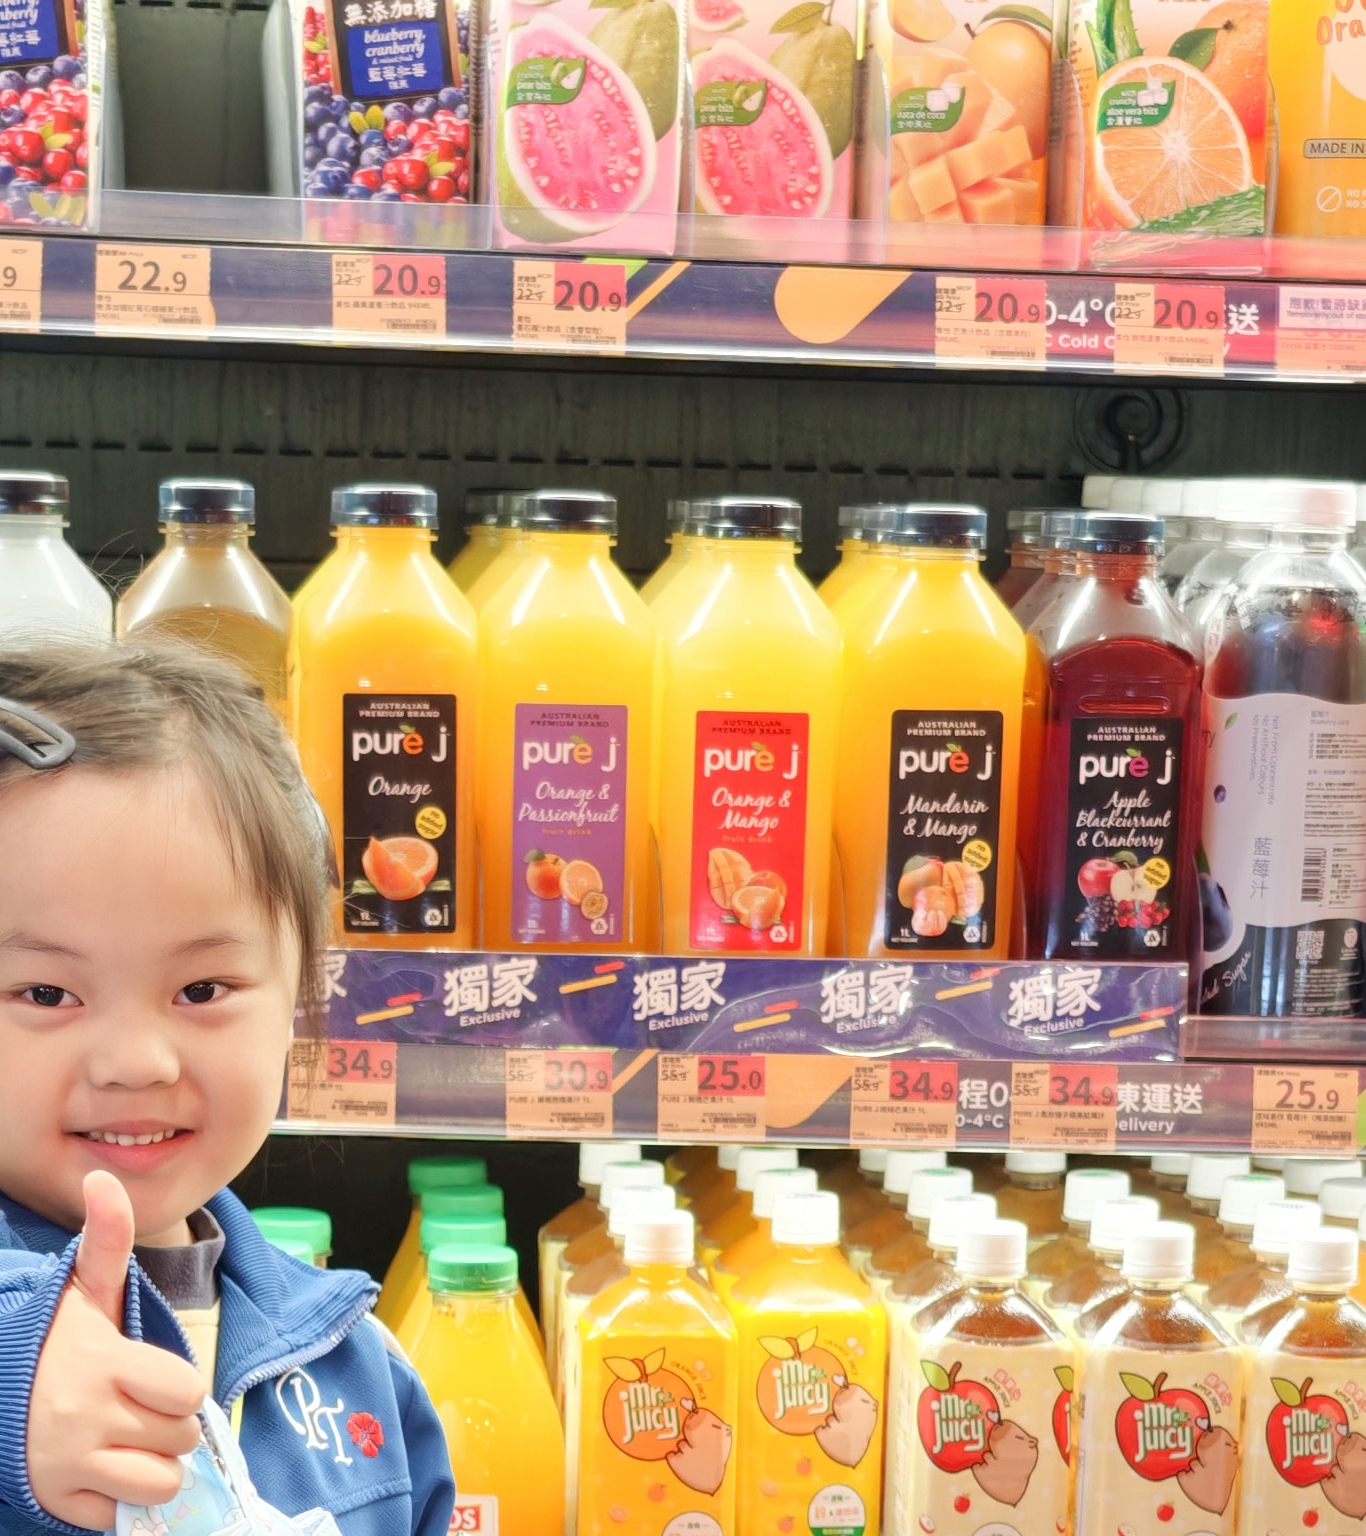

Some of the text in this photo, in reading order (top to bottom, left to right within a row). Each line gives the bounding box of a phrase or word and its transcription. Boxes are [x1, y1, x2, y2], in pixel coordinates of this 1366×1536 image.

[1310, 142, 1347, 155] MADE
[1351, 142, 1365, 154] IN
[118, 260, 188, 292] 22.9
[374, 263, 441, 296] 20.9
[555, 280, 623, 313] 20.9
[976, 291, 1040, 324] 20.9
[1154, 298, 1219, 331] 20.9
[906, 729, 987, 737] PREMIUM BRAND
[918, 721, 976, 729] AUSTRALIAN
[1087, 734, 1166, 742] PREMIUM BRAND
[1098, 726, 1157, 734] AUSTRALIAN
[368, 776, 433, 804] Orange
[535, 782, 596, 808] Orange
[712, 788, 774, 814] Orange
[1107, 790, 1151, 812] Apple
[518, 803, 619, 827] Passionfruit
[900, 793, 989, 816] Mandarin
[717, 808, 779, 834] Mango
[918, 818, 977, 842] Mango
[1076, 808, 1171, 830] Blackcurrant
[1091, 830, 1164, 853] Cranberry
[443, 957, 538, 1017] 獨家
[633, 961, 726, 1022] 獨家
[819, 965, 914, 1024] 獨家
[1008, 968, 1102, 1027] 獨家
[459, 1007, 521, 1028] Exclusive
[648, 1011, 710, 1032] Exclusive
[327, 1047, 393, 1081] 34.9
[544, 1059, 609, 1091] 30.9
[697, 1059, 763, 1091] 25.0
[890, 1069, 954, 1102] 34.9
[1051, 1075, 1113, 1107] 34.9
[1276, 1078, 1340, 1111] 25.9
